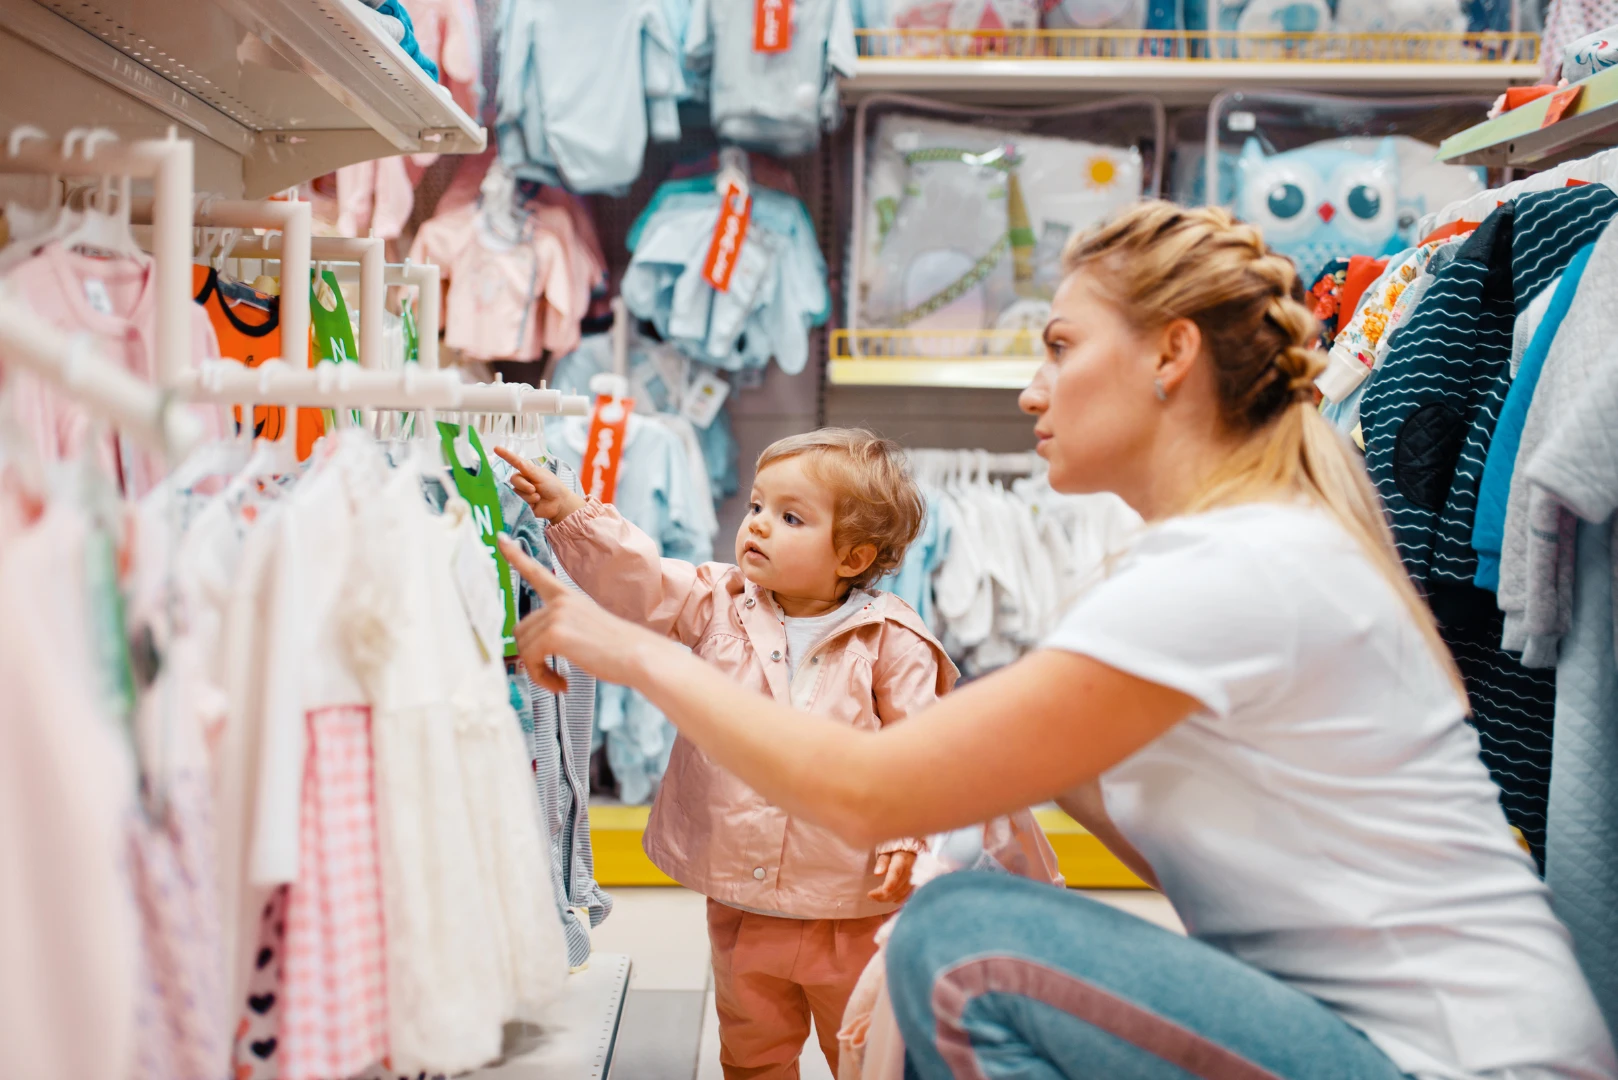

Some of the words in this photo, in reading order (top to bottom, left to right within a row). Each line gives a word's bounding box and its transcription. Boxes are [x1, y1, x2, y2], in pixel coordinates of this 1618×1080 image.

[762, 0, 783, 47] ALE
[711, 215, 740, 284] SALE
[589, 427, 615, 501] SALE
